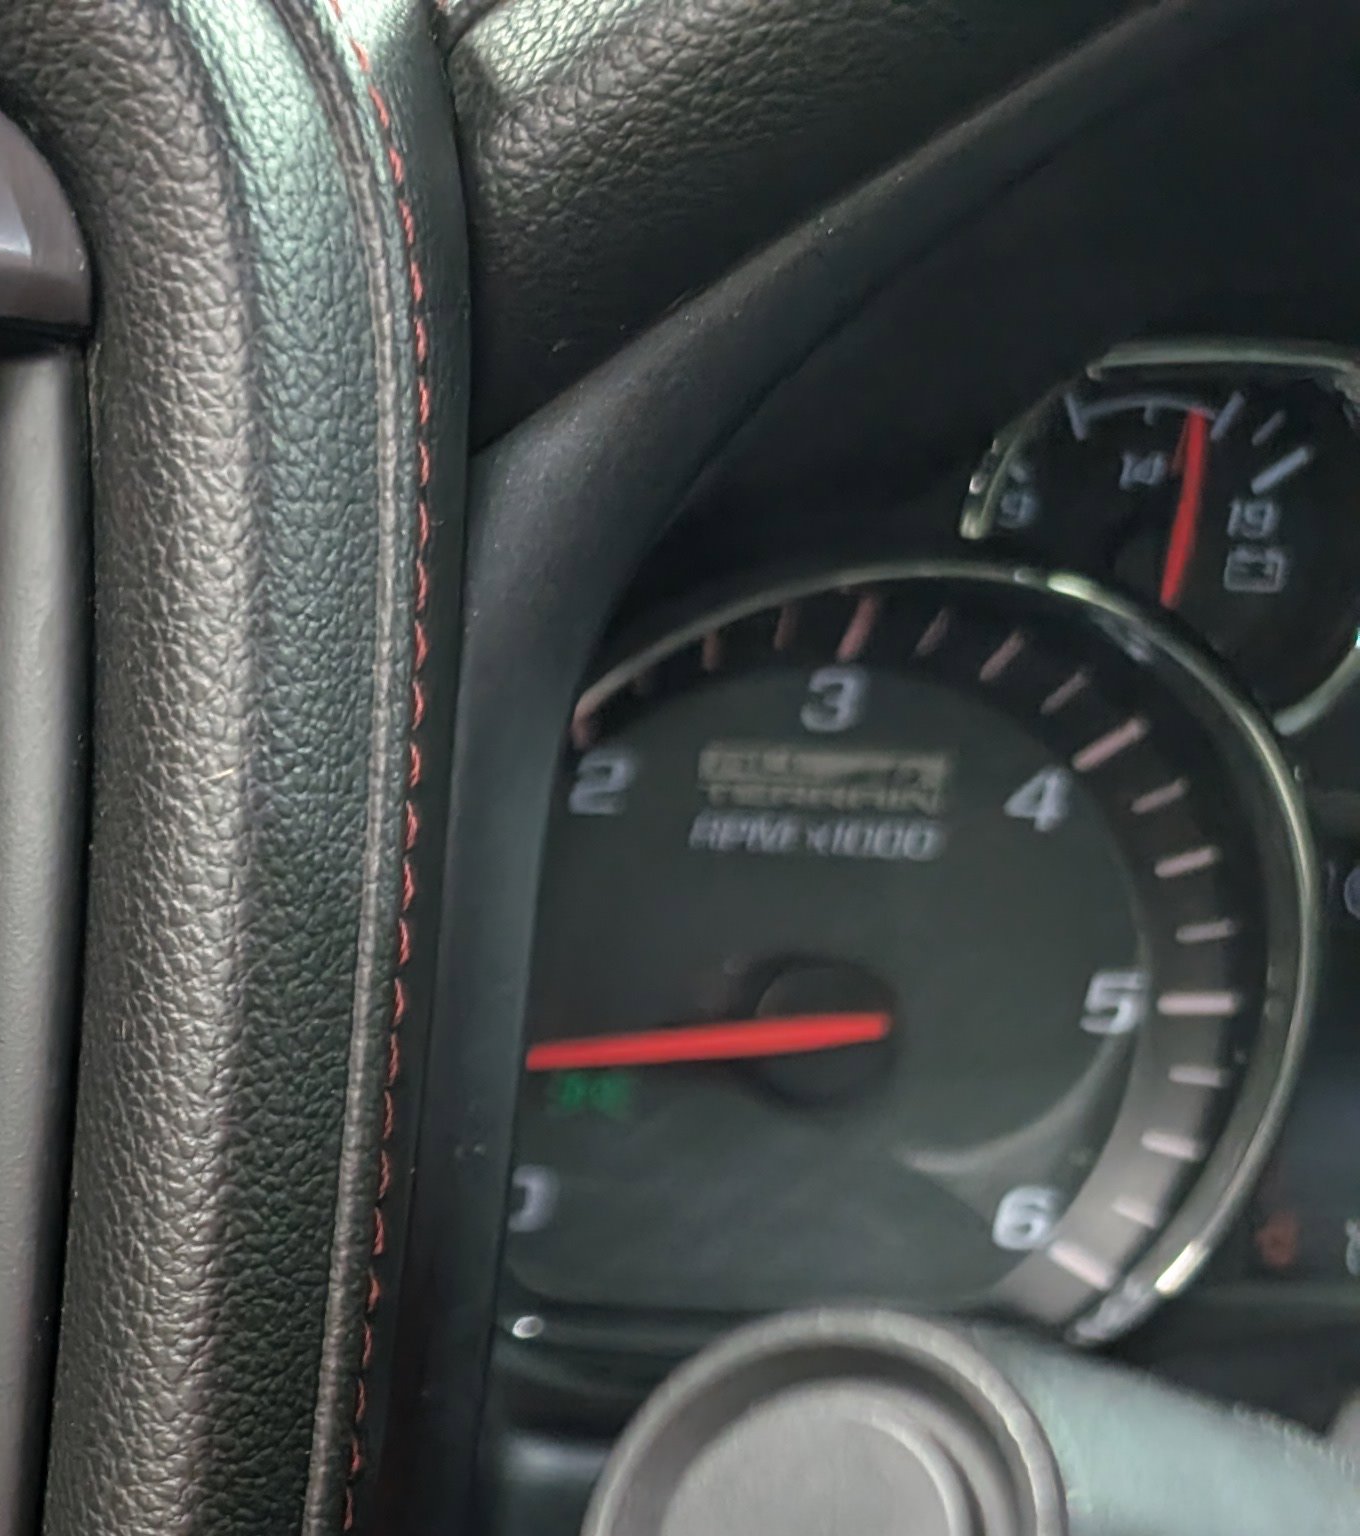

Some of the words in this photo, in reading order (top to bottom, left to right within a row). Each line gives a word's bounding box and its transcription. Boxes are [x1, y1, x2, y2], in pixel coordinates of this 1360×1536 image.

[1226, 499, 1277, 539] 19
[800, 669, 866, 732] 3
[569, 750, 634, 815] 2
[1005, 768, 1070, 830] 4
[1082, 968, 1143, 1035] 5
[993, 1186, 1061, 1251] 6
